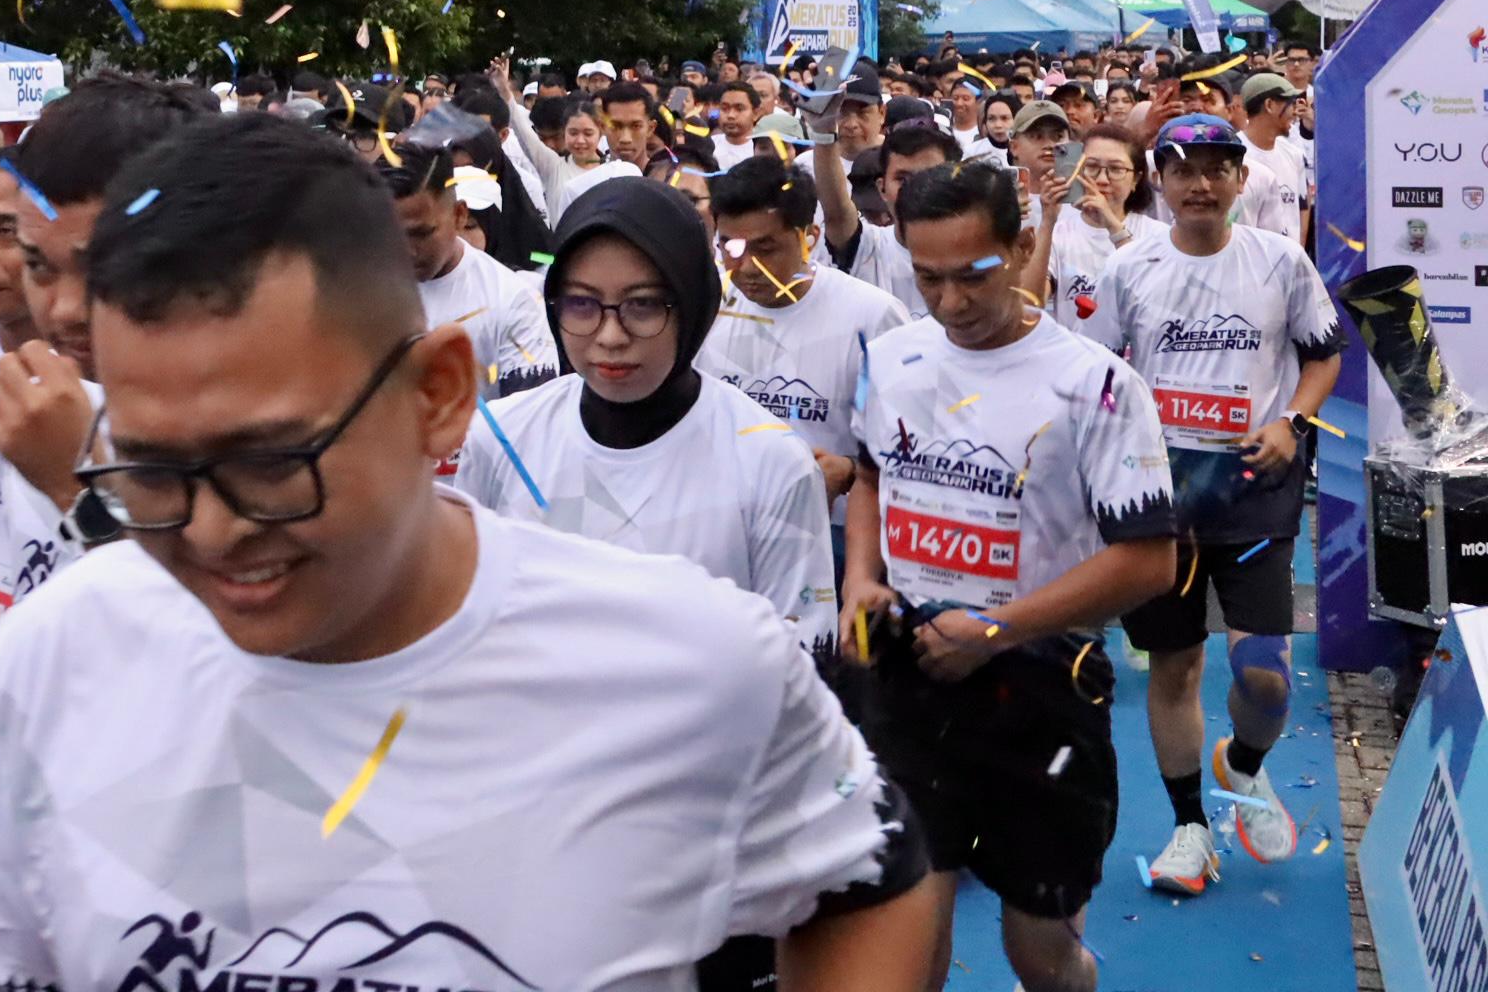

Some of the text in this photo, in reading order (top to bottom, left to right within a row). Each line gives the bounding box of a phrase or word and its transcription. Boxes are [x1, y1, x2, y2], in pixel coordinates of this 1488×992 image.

[790, 3, 846, 26] MERATUS
[18, 83, 43, 105] plus
[1395, 191, 1440, 204] DAZZLE ME
[1174, 339, 1260, 351] GEOPARK RUN
[1176, 329, 1247, 341] MERATUS
[749, 392, 811, 407] ERATUS
[1171, 398, 1223, 423] 1144
[1231, 411, 1245, 420] 5K
[789, 409, 828, 422] UN
[904, 455, 1002, 482] MERATUS
[902, 468, 1024, 500] GEOPARK RUN
[889, 522, 1011, 565] M 1470 5K
